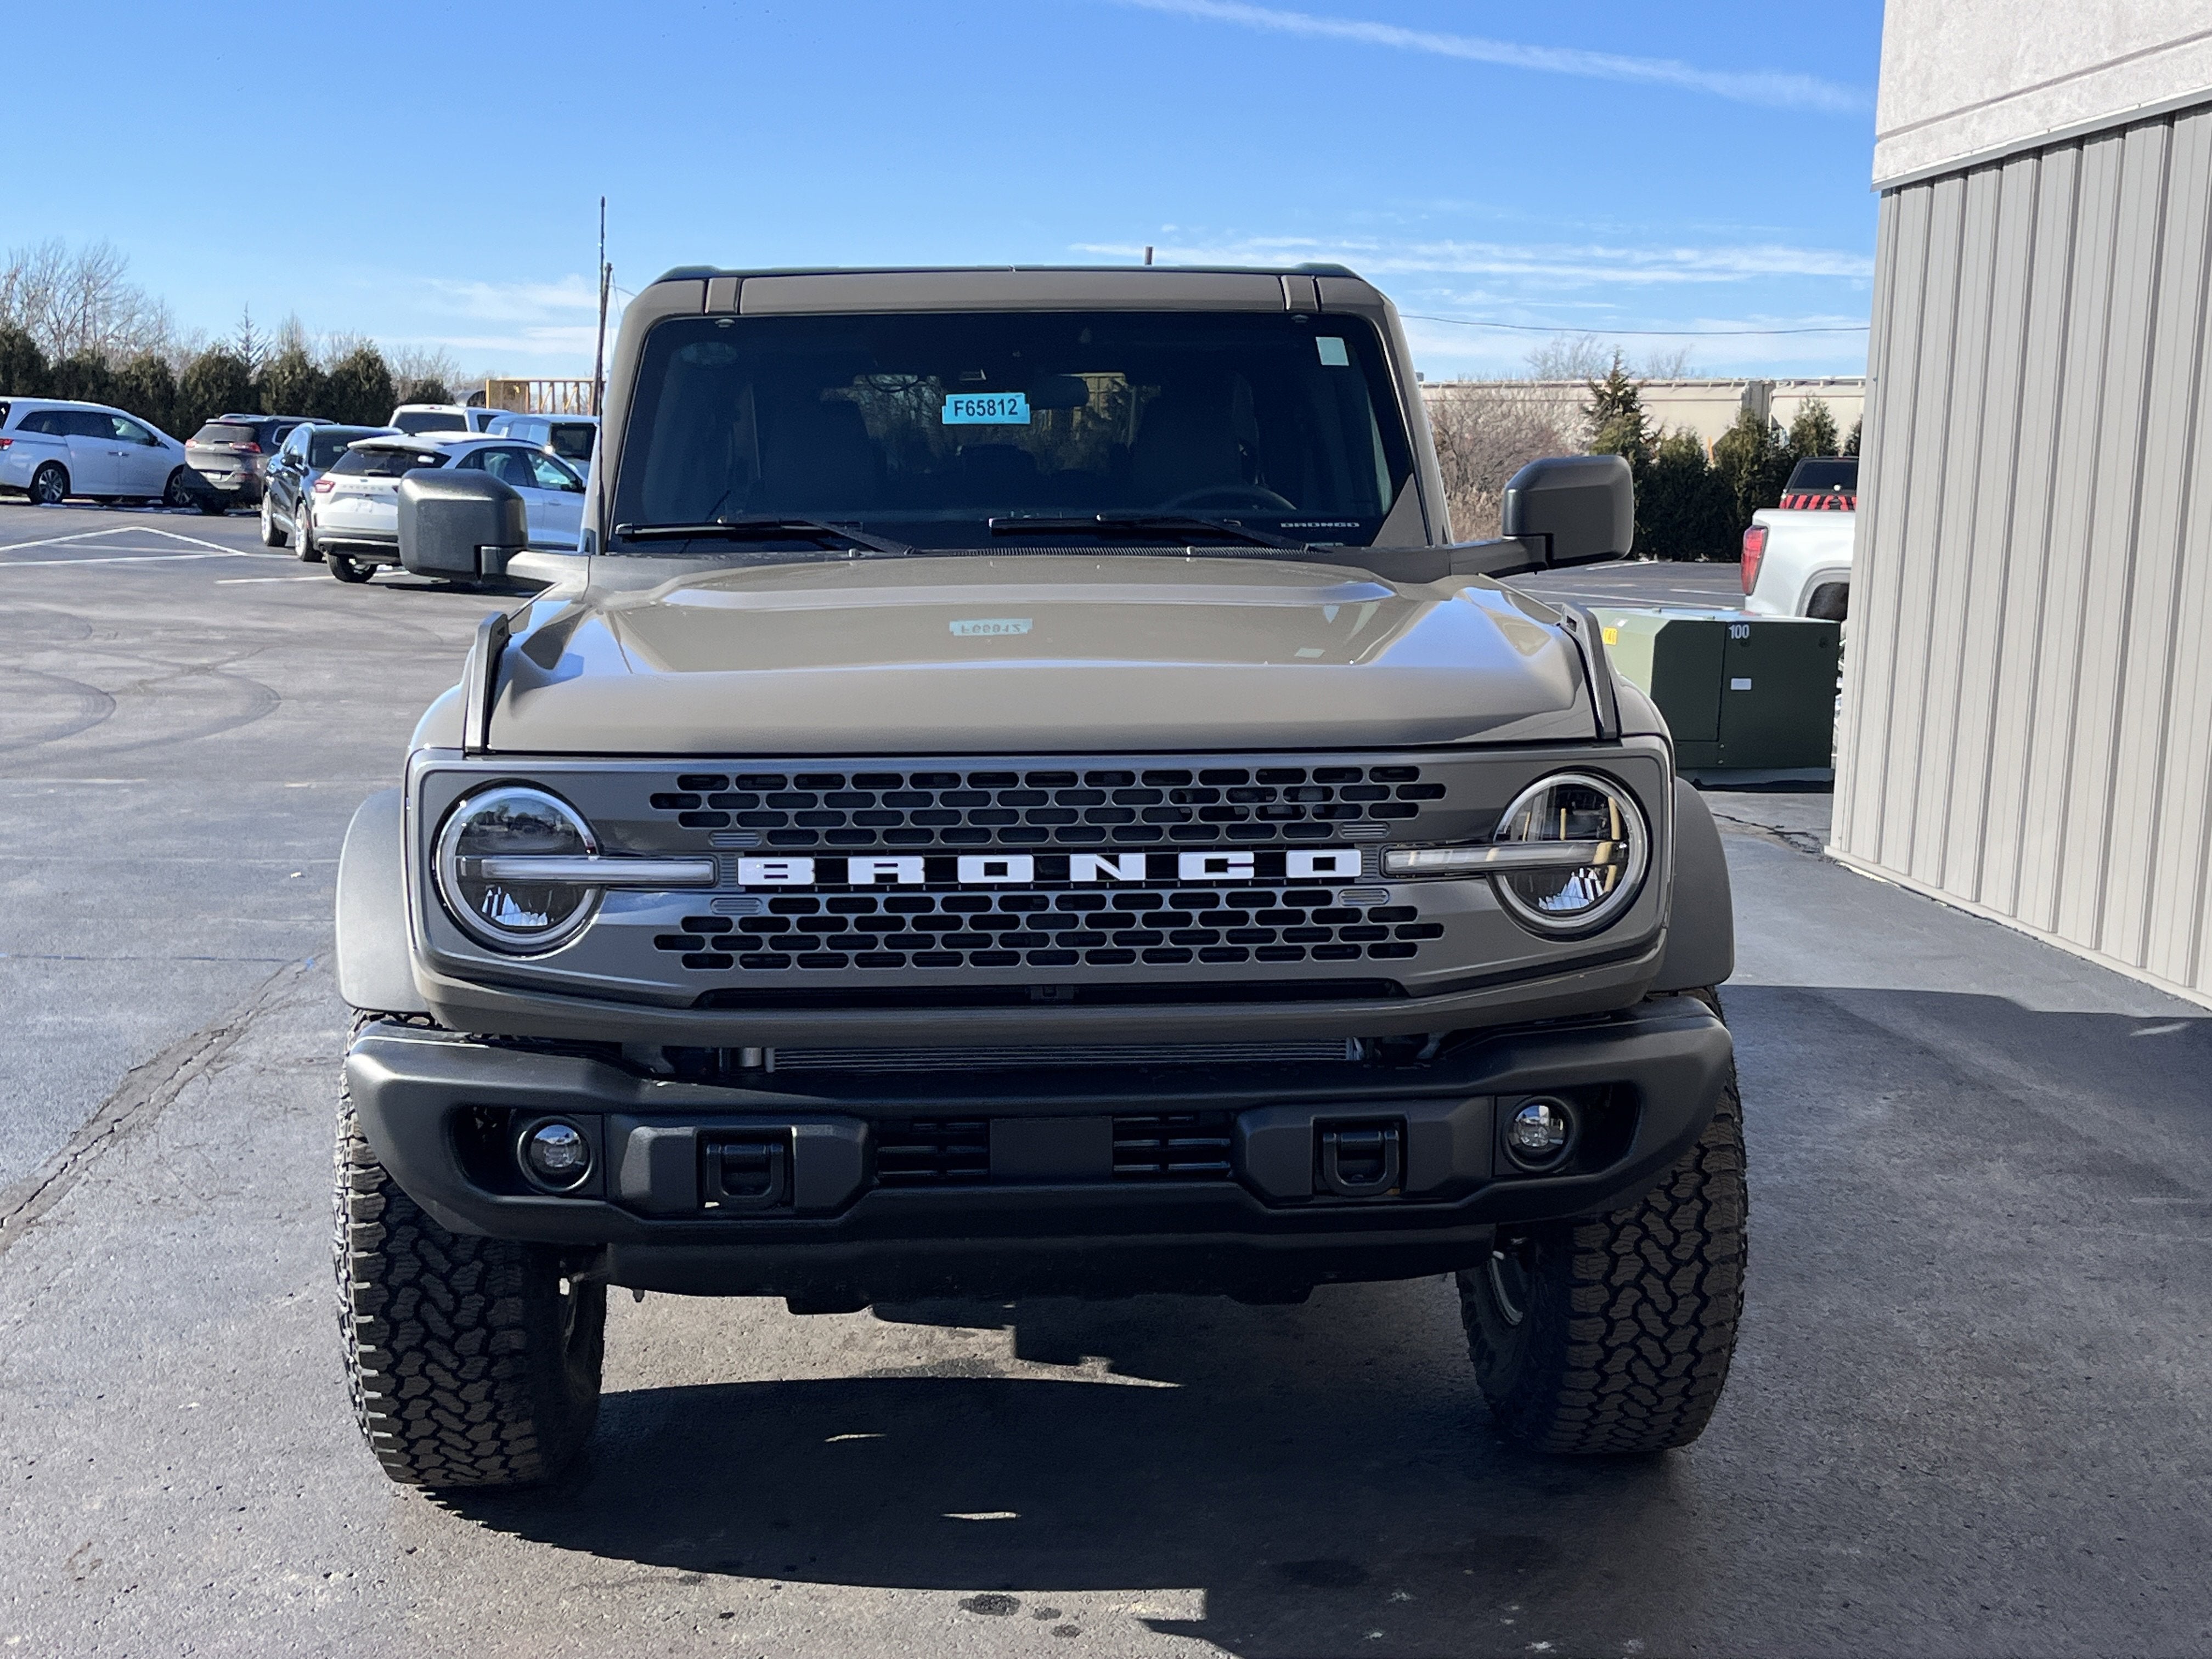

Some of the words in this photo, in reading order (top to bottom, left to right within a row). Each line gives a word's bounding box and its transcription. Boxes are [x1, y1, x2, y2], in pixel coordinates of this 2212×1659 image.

[954, 398, 1018, 417] F65812
[1729, 624, 1750, 639] 100
[737, 849, 1362, 885] BRONCO
